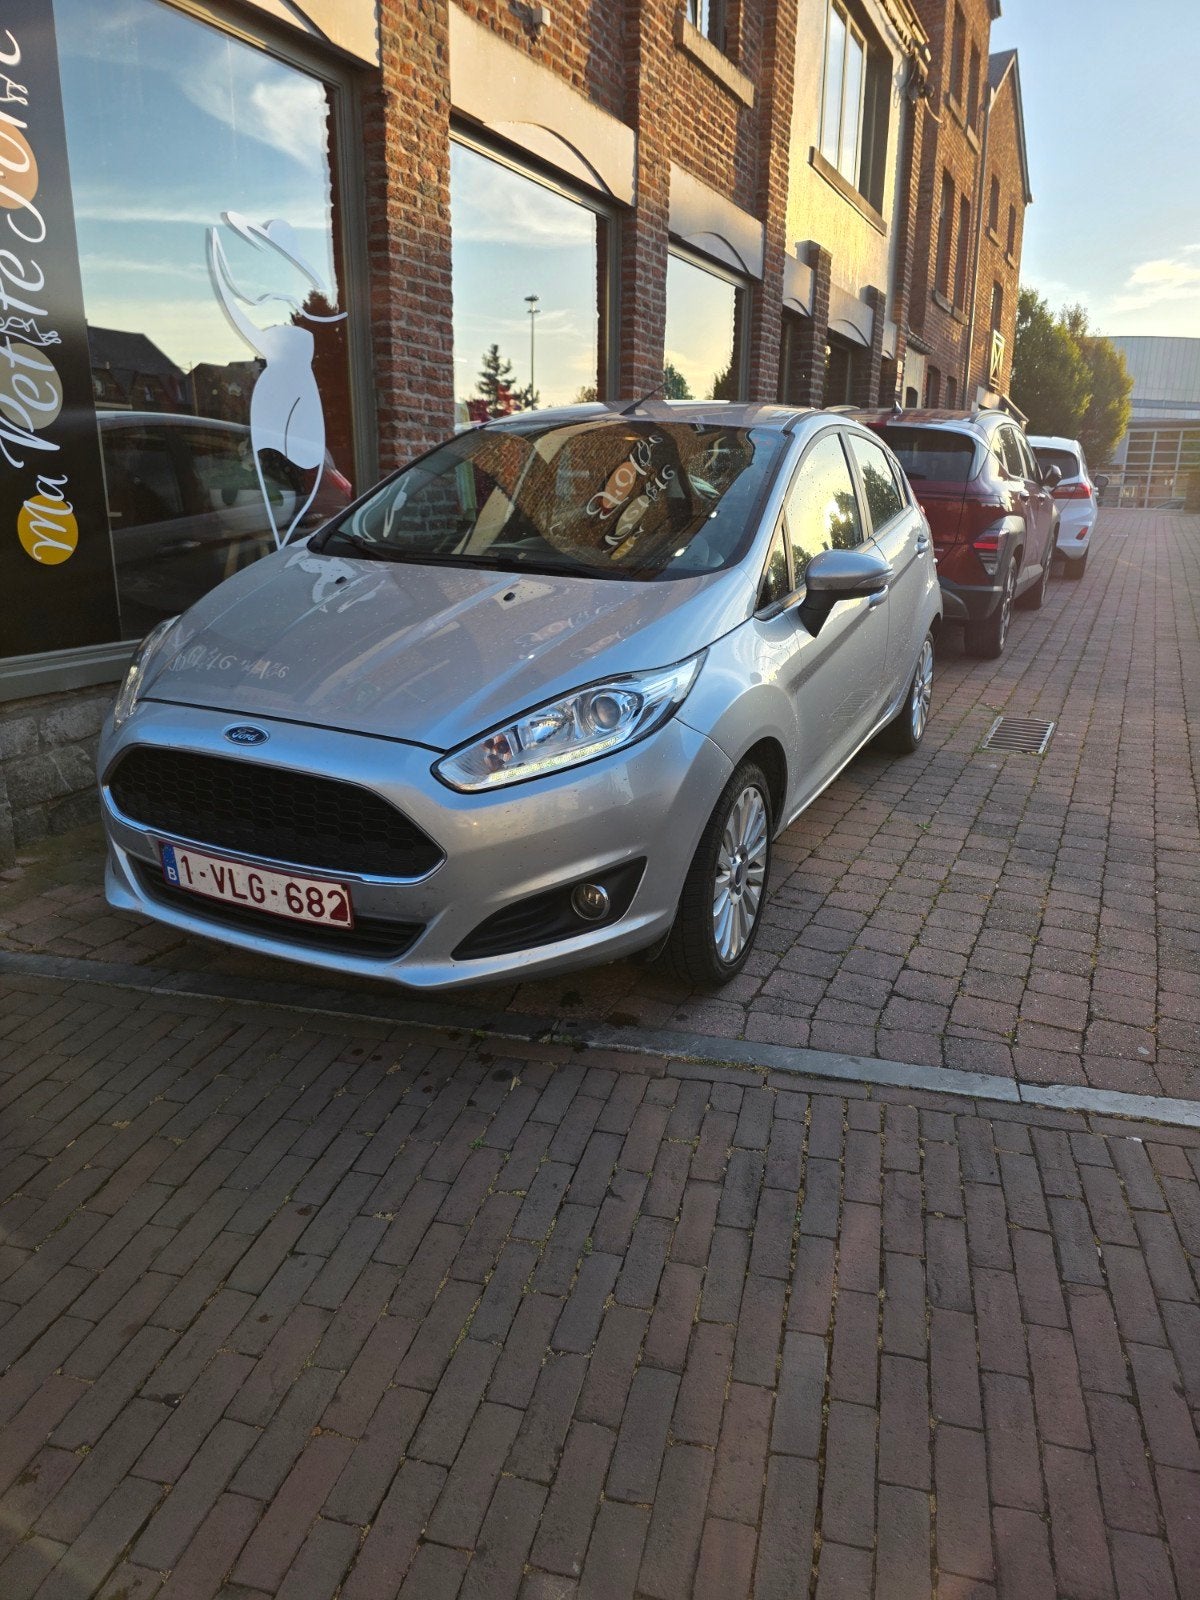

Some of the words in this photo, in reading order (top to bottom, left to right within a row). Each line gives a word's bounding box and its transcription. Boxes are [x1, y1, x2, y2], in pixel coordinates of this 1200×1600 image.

[23, 474, 74, 560] Ma
[231, 727, 259, 742] Ford
[166, 866, 178, 881] B
[180, 855, 349, 922] 1-VLG-682
